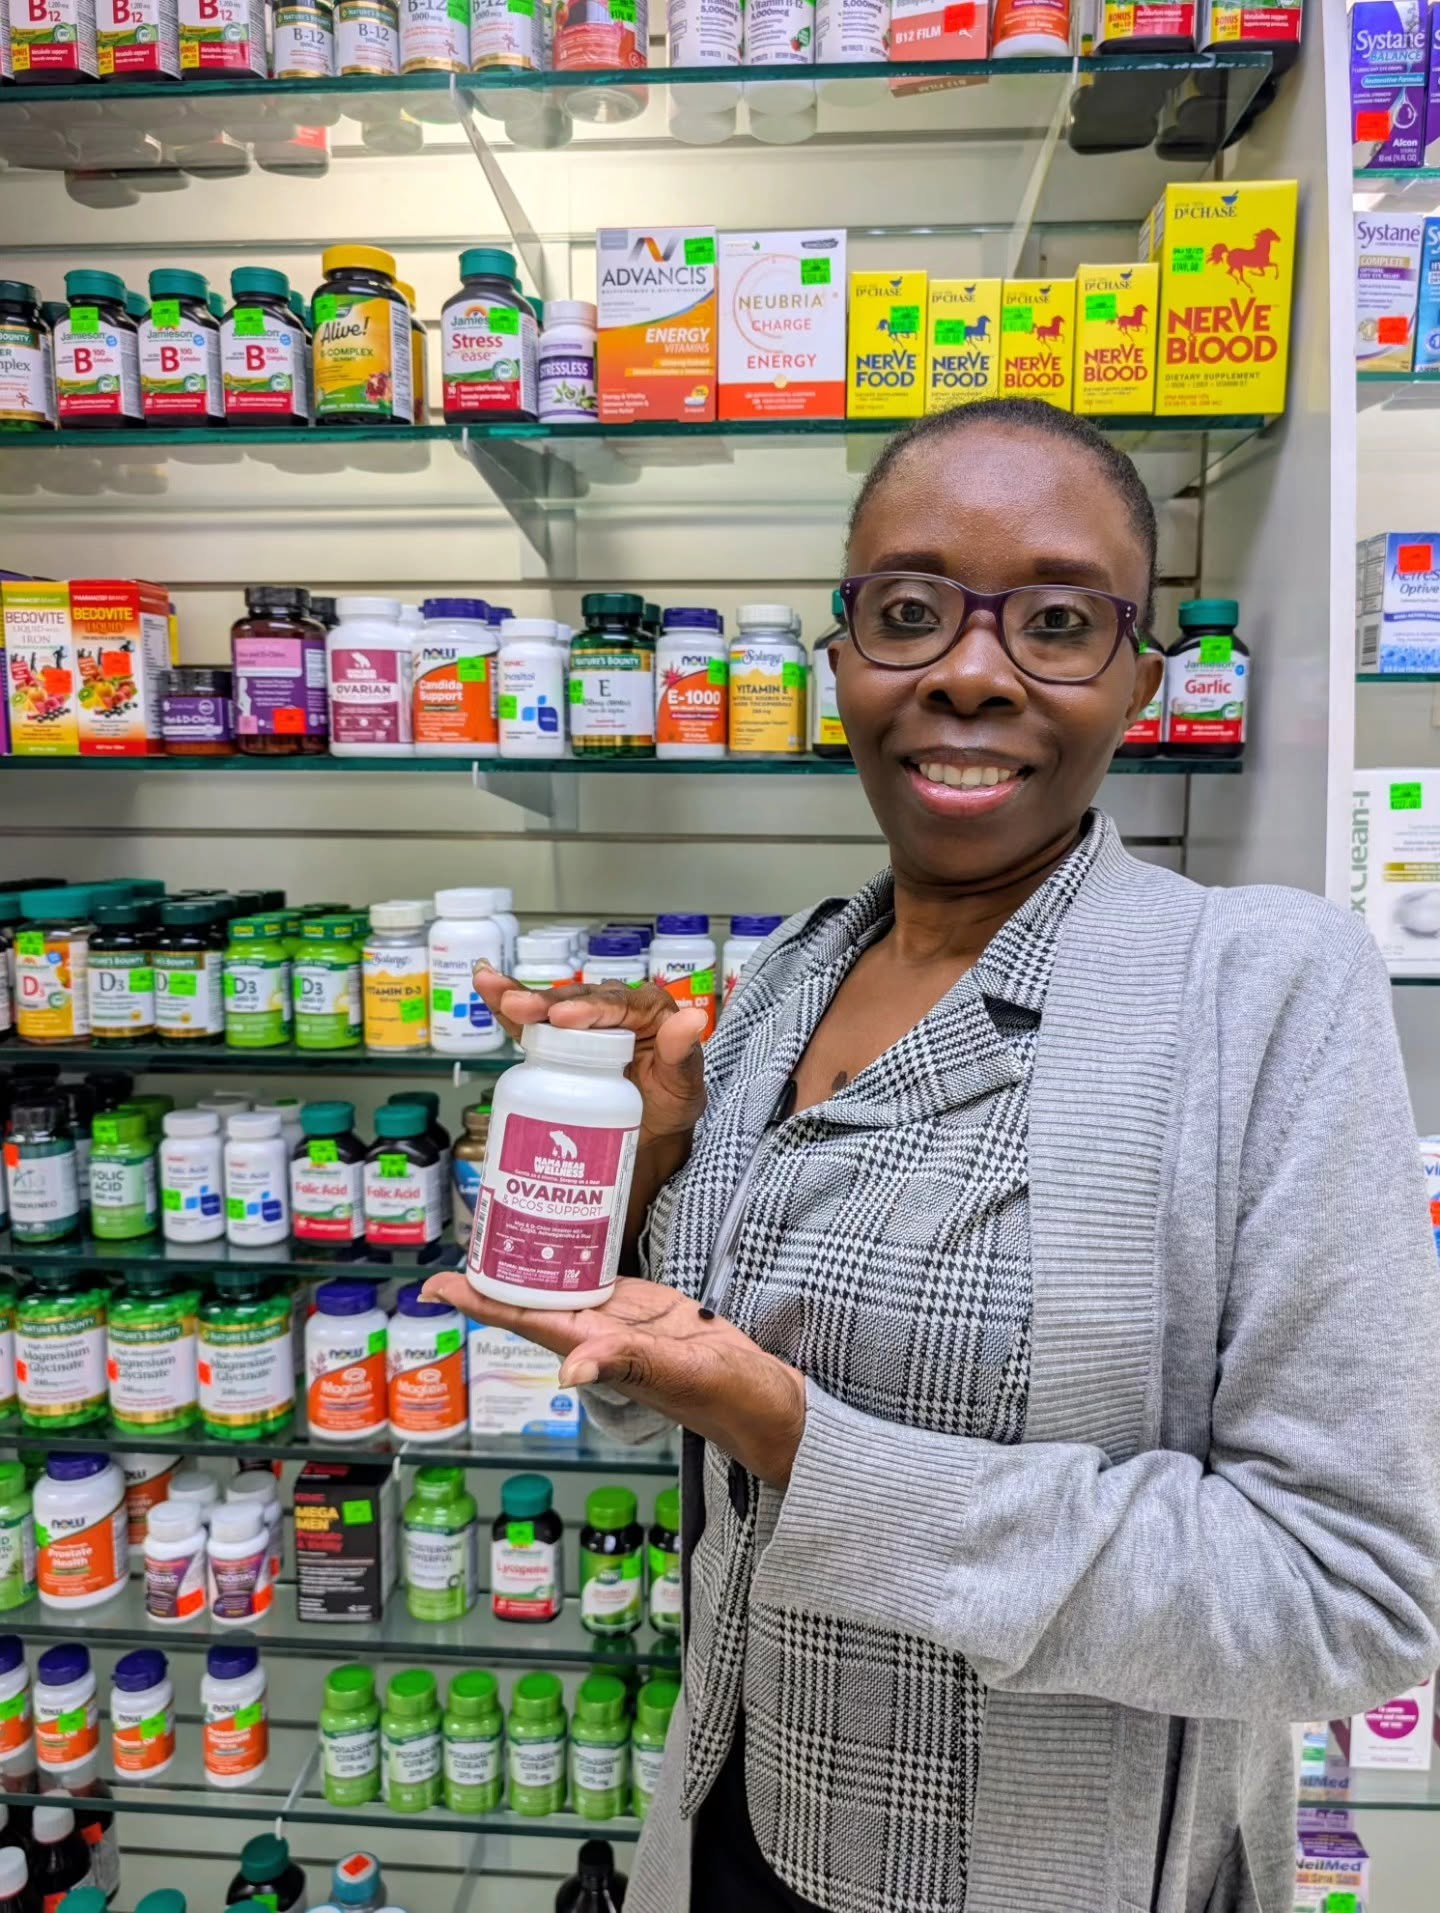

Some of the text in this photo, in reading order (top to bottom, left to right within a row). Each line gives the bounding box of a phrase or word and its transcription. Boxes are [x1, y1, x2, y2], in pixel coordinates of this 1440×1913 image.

[29, 0, 47, 21] B
[113, 0, 130, 24] B
[199, 0, 218, 19] B
[294, 28, 324, 44] B-12
[359, 24, 389, 41] B-12
[895, 25, 941, 44] B12 FILM
[1355, 30, 1425, 58] Systane
[1371, 51, 1423, 61] BALANCE
[1392, 138, 1418, 147] Alcon
[1191, 207, 1237, 219] CHASE
[1357, 222, 1420, 248] Systane
[602, 267, 706, 286] ADVANCIS
[867, 286, 902, 297] CHASE
[1097, 279, 1132, 290] CHASE
[738, 294, 823, 310] NEUBRIA
[943, 292, 976, 303] CHASE
[1018, 294, 1051, 304] CHASE
[1168, 297, 1272, 334] NERVE
[321, 317, 370, 347] Alive!
[752, 319, 812, 332] CHARGE
[147, 329, 193, 340] Jamieson
[452, 334, 502, 349] Stress
[645, 328, 711, 343] ENERGY
[665, 343, 710, 353] VITAMINS
[1084, 344, 1144, 365] NERVE
[1165, 333, 1277, 365] BLOOD
[74, 348, 93, 373] B
[160, 347, 179, 372] B
[246, 345, 266, 370] B
[462, 351, 491, 362] ease
[747, 354, 817, 369] ENERGY
[856, 350, 917, 370] NERVE
[932, 351, 990, 371] NERVE
[1005, 353, 1061, 372] NERVE
[540, 362, 588, 378] STRESSLESS
[1084, 366, 1148, 383] BLOOD
[1165, 371, 1260, 381] DIETARY SUPPLEMENT
[855, 371, 915, 388] FOOD
[932, 372, 988, 388] FOOD
[1004, 371, 1064, 389] BLOOD
[1400, 584, 1440, 597] Optive
[5, 612, 65, 624] BECOVITE
[73, 607, 133, 620] BECOVITE
[85, 623, 125, 633] LIQUID
[23, 635, 50, 644] IRON
[575, 657, 639, 666] NATURE'S BOUNTY
[336, 684, 391, 695] OVARIAN
[419, 679, 463, 691] Candida
[599, 679, 611, 697] E
[736, 685, 780, 693] VITAMIN
[1185, 679, 1232, 694] Garlic
[420, 692, 463, 703] Support
[668, 690, 721, 705] E-1000
[433, 959, 468, 968] Vitamin
[99, 972, 124, 992] D3
[234, 977, 257, 994] D3
[302, 978, 323, 995] D3
[92, 1171, 125, 1181] FOLIC
[95, 1182, 122, 1192] ACID
[295, 1182, 347, 1195] Folic Acid
[367, 1185, 420, 1199] Folic Acid
[506, 1178, 603, 1205] OVARIAN
[503, 1194, 603, 1217] & PCOS SUPPORT
[60, 1317, 95, 1333] BOUNTY
[149, 1326, 180, 1339] BOUNTY
[247, 1325, 281, 1340] BOUNTY
[24, 1345, 90, 1361] Magnesium
[29, 1360, 85, 1373] Glycinate
[118, 1369, 170, 1380] Glycinate
[216, 1370, 271, 1382] Glycinate
[295, 1506, 339, 1520] MEGA
[295, 1520, 330, 1531] MEN
[48, 1547, 93, 1558] Prostate
[52, 1558, 88, 1568] Health
